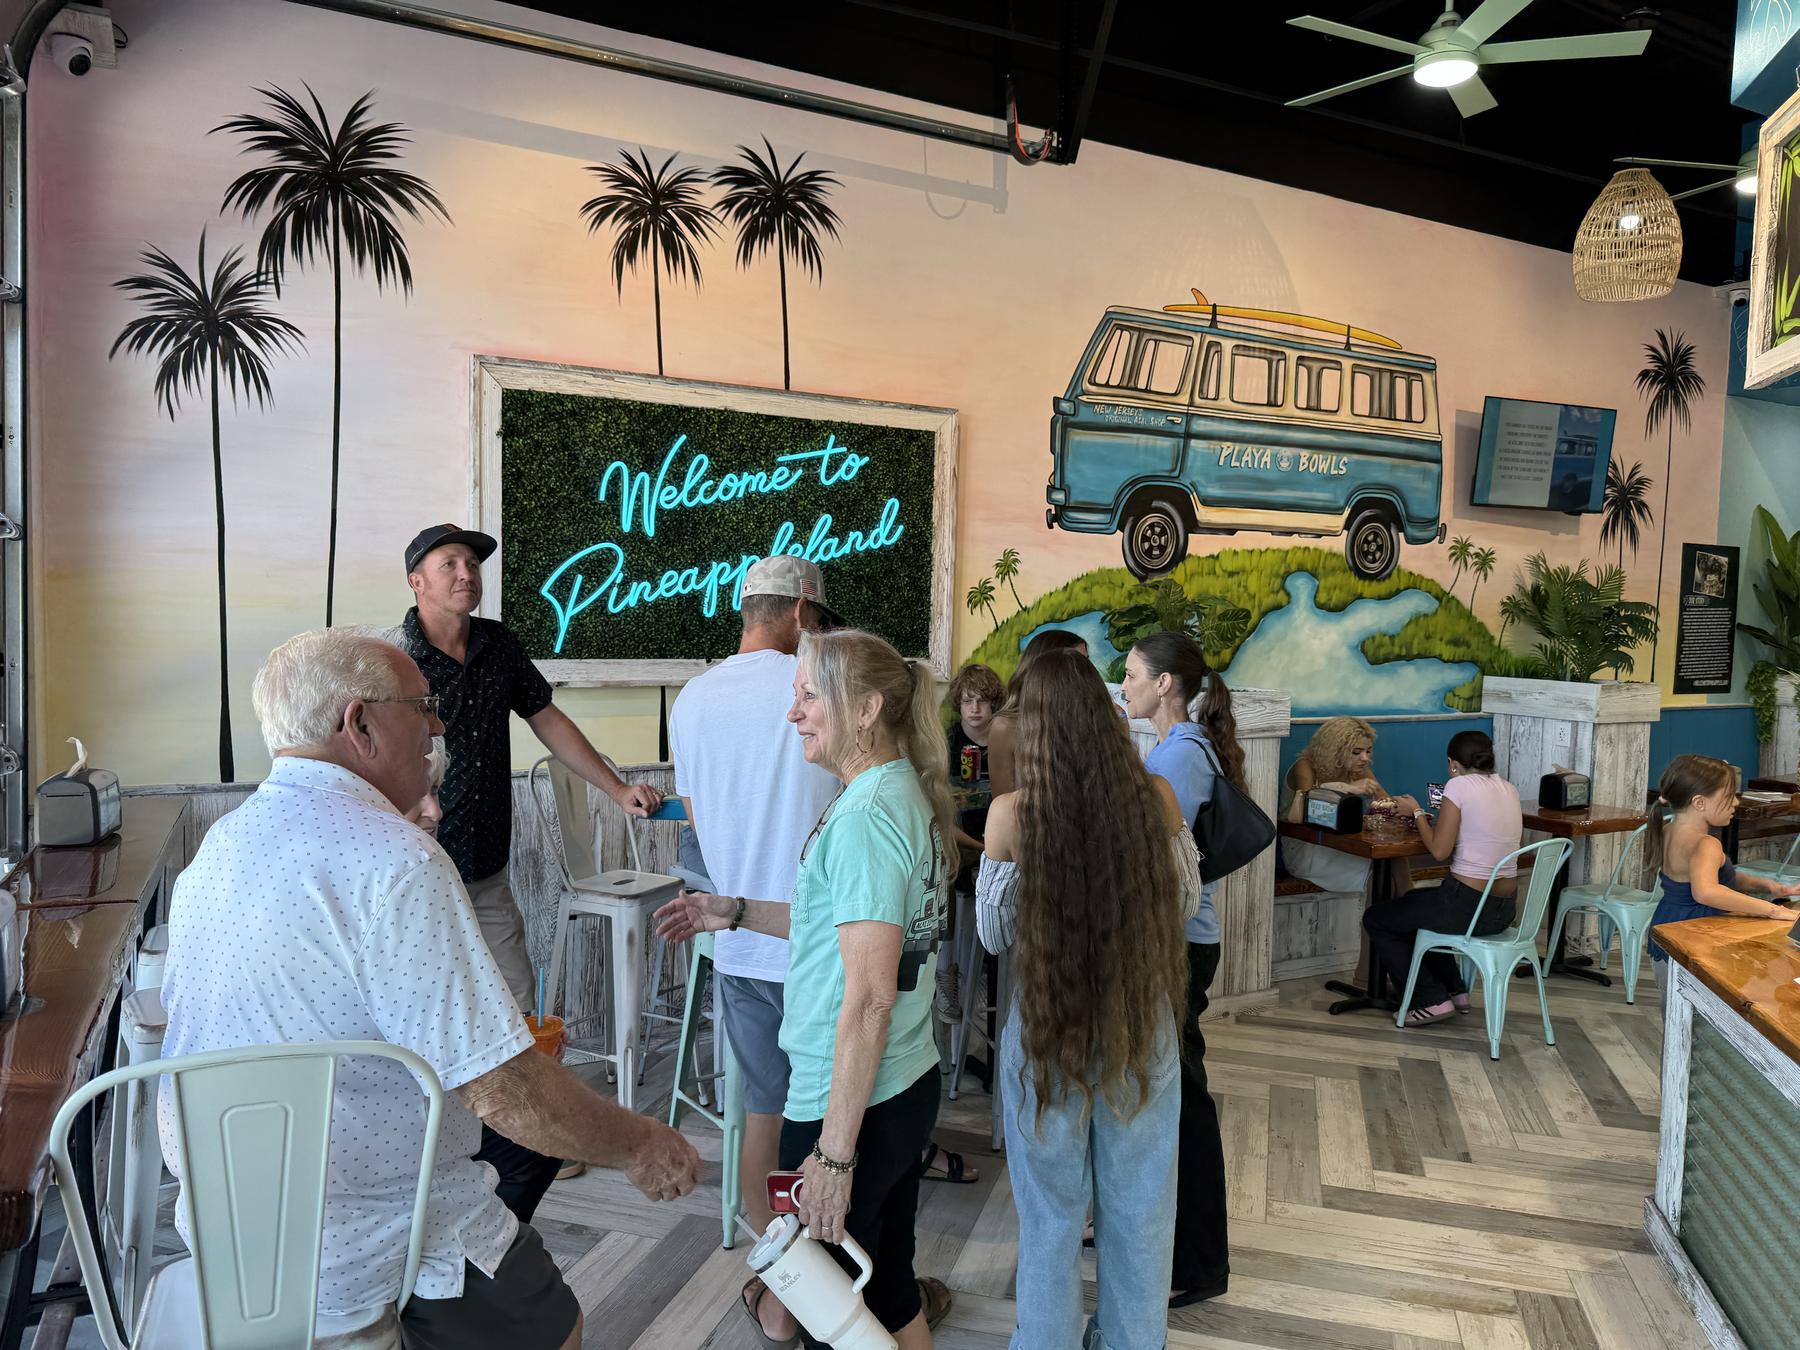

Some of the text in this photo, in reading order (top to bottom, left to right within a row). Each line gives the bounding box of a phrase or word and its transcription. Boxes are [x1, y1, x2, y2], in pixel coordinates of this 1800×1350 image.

[1093, 404, 1111, 415] NEW
[1218, 442, 1349, 476] PLAYA BOWLS
[598, 434, 870, 538] Welcome to
